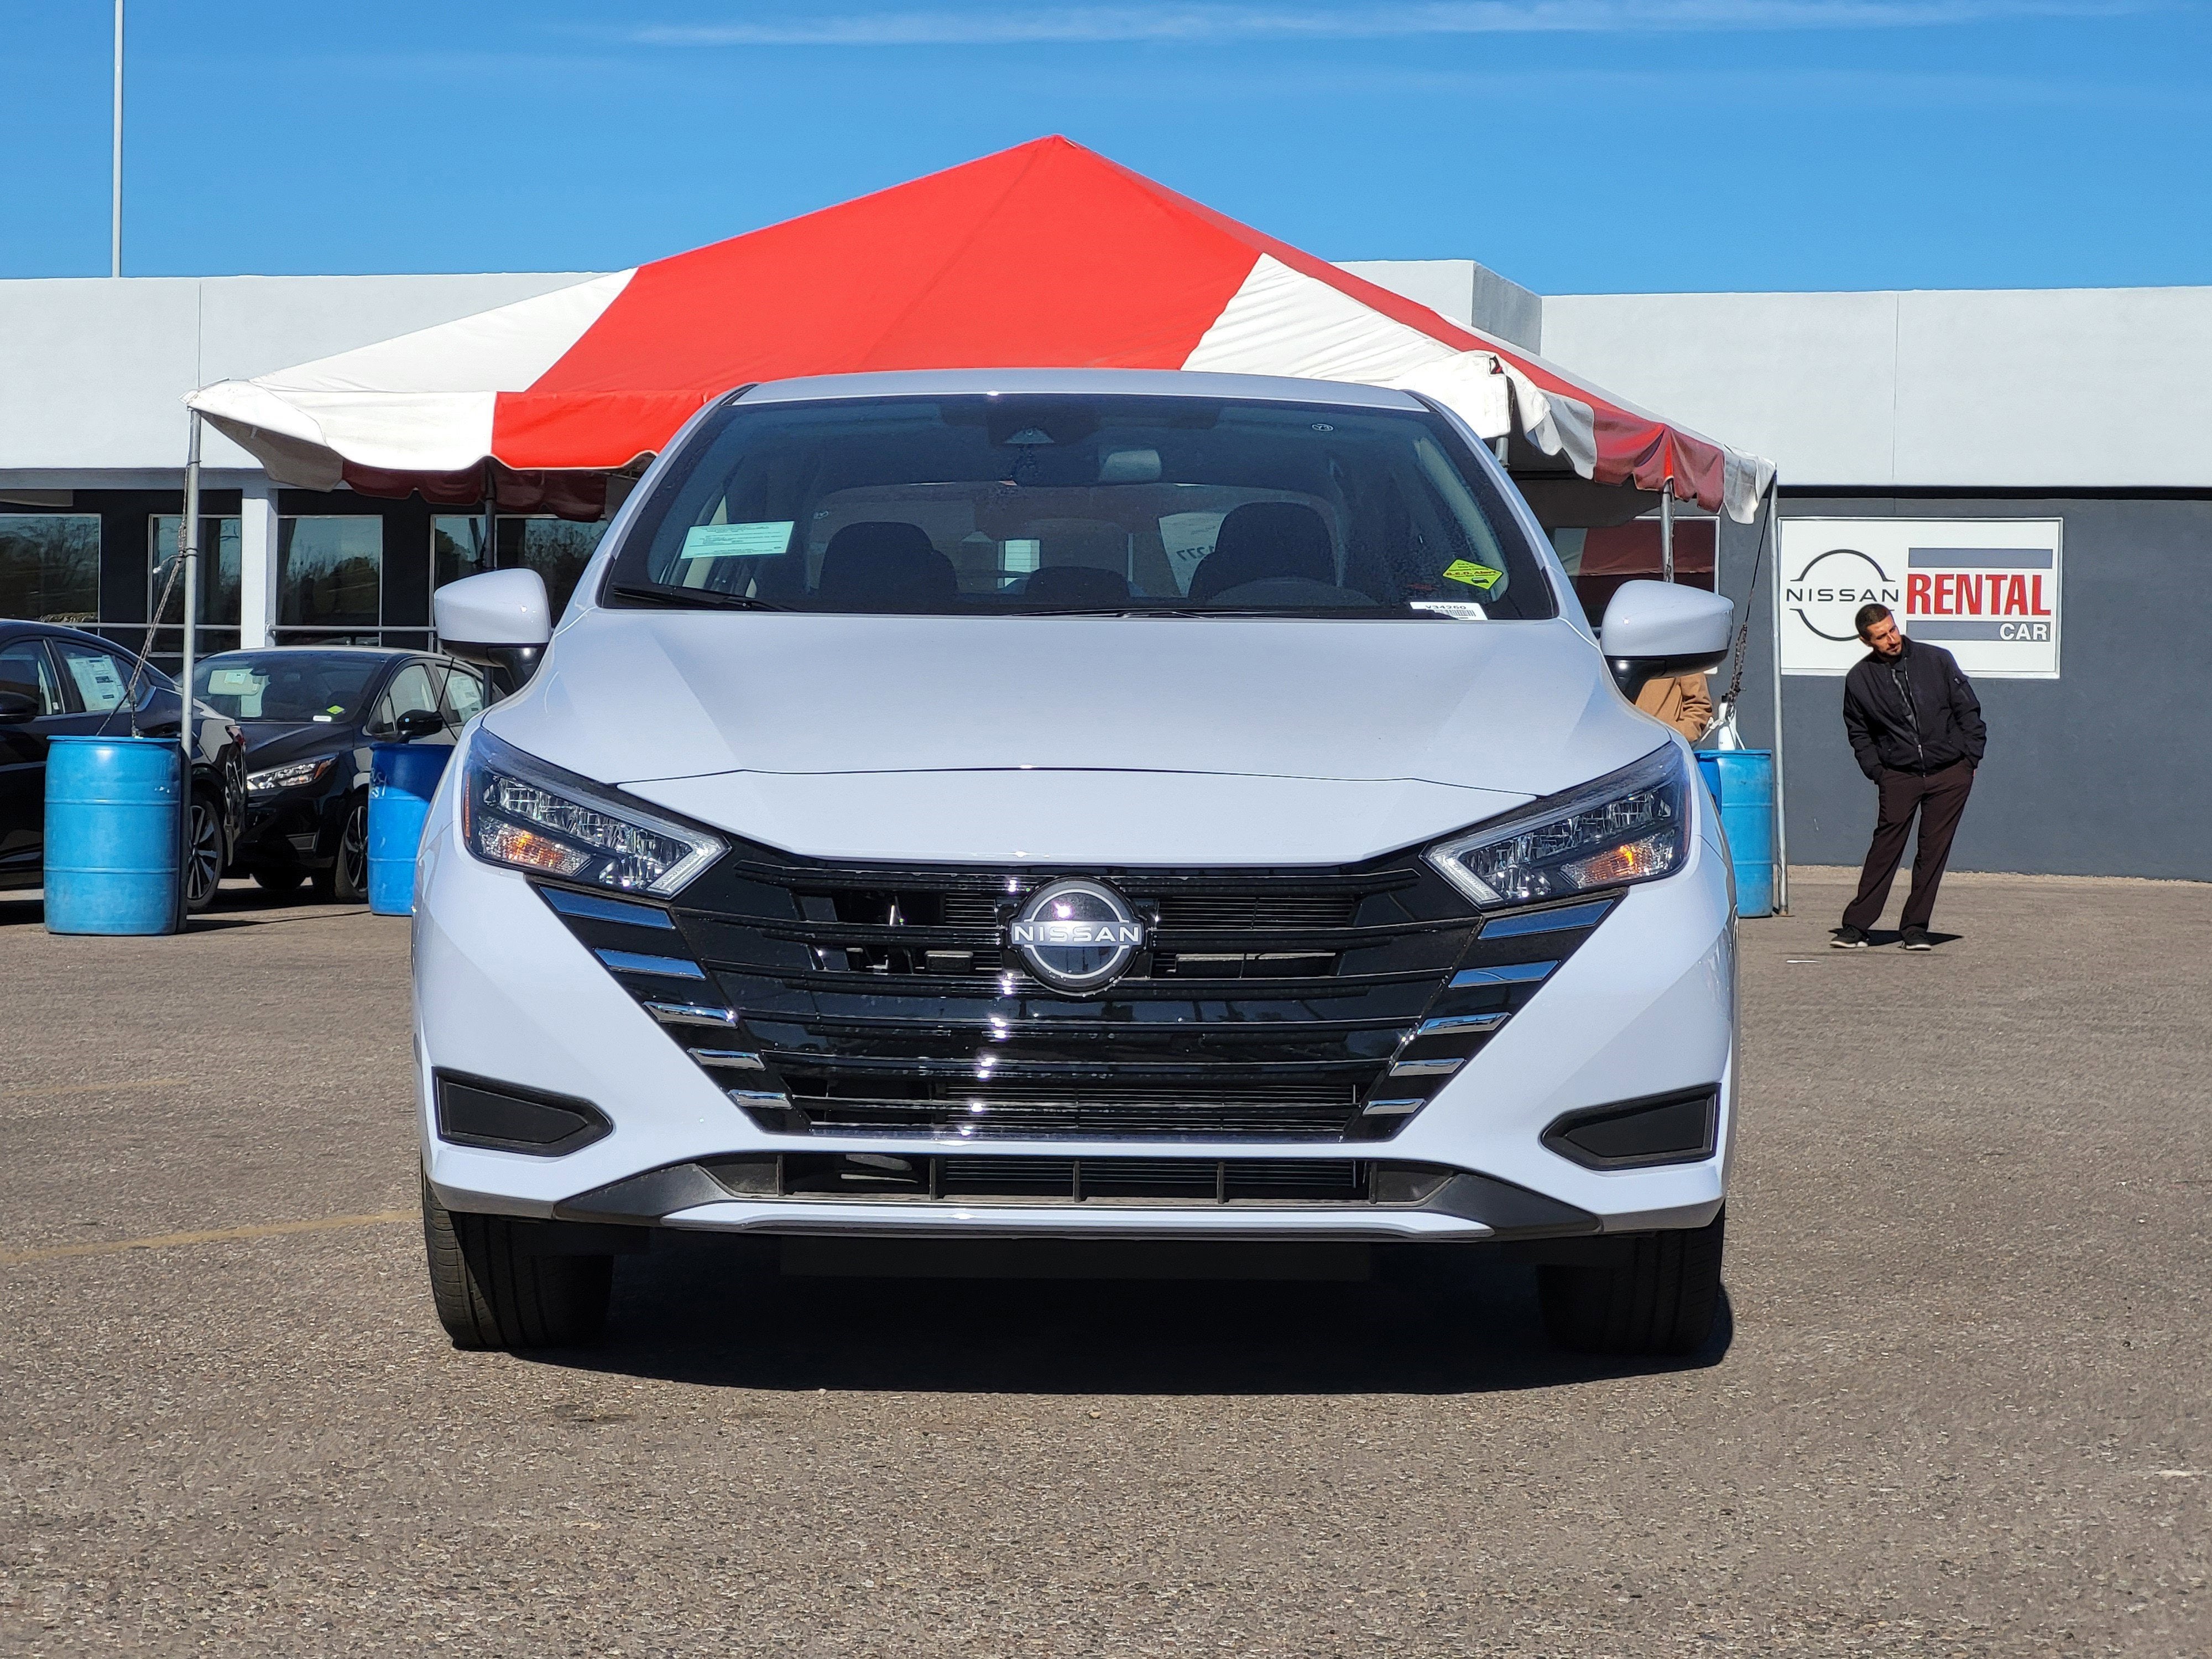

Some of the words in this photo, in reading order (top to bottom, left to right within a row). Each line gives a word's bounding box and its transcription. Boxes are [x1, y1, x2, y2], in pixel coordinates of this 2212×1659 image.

[1786, 588, 1898, 602] NISSAN
[1906, 573, 2051, 615] RENTAL
[1999, 623, 2047, 640] CAR
[1015, 926, 1139, 942] NISSAN
